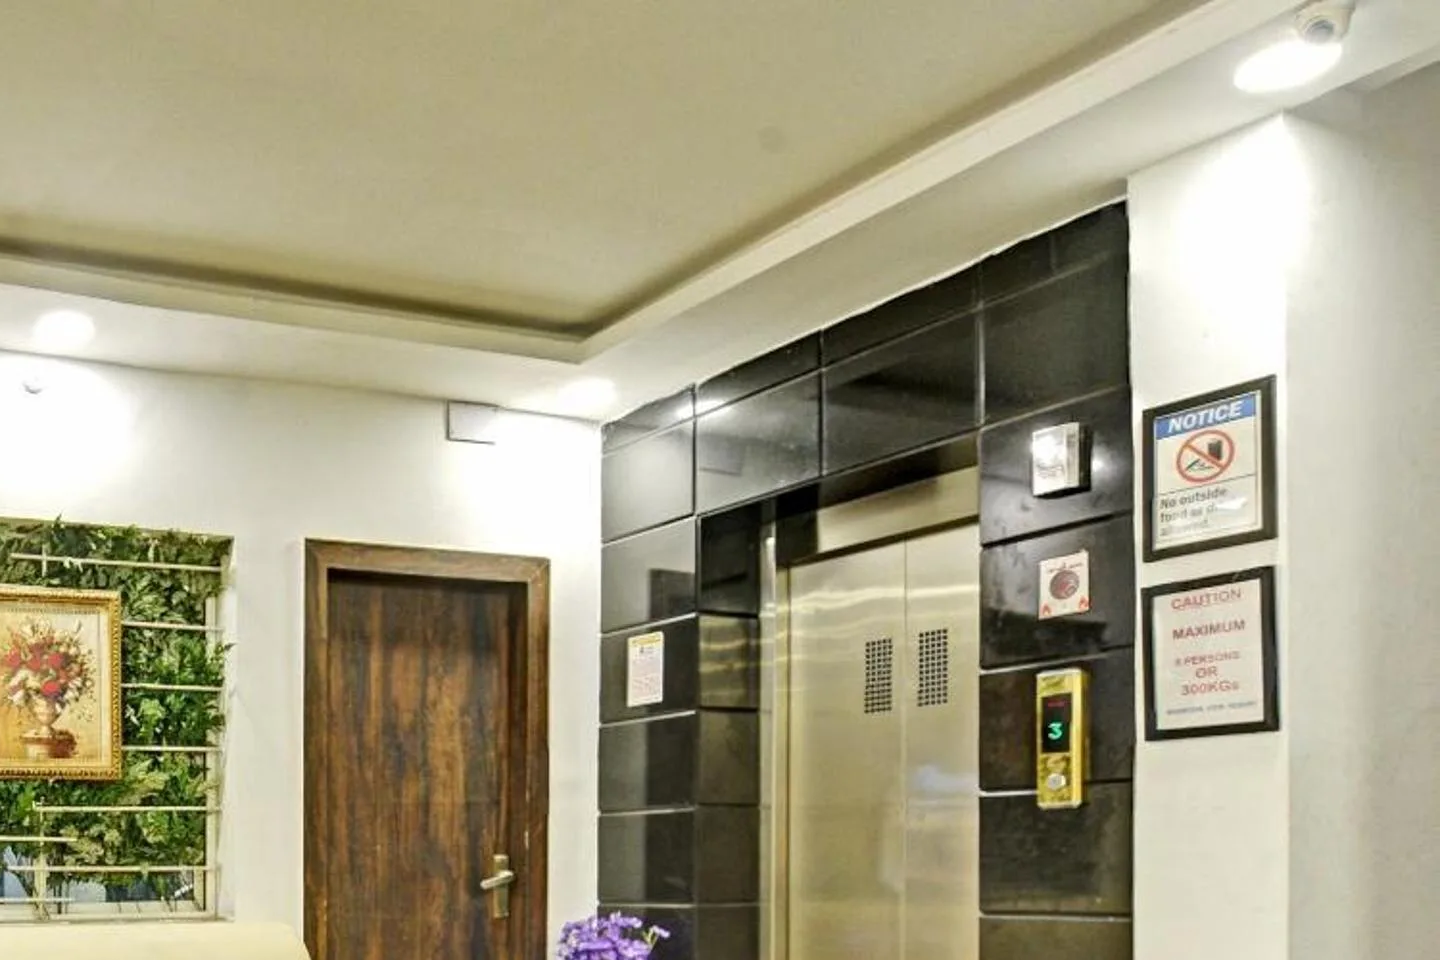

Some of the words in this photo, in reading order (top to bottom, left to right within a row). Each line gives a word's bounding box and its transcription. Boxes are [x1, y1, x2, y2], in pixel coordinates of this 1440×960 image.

[1168, 401, 1243, 433] NOTICE
[1171, 588, 1241, 609] CAUTION
[1172, 619, 1245, 640] MAXIMUM
[1184, 650, 1240, 666] PERSONS
[1195, 666, 1217, 679] OR
[1047, 721, 1063, 740] 3
